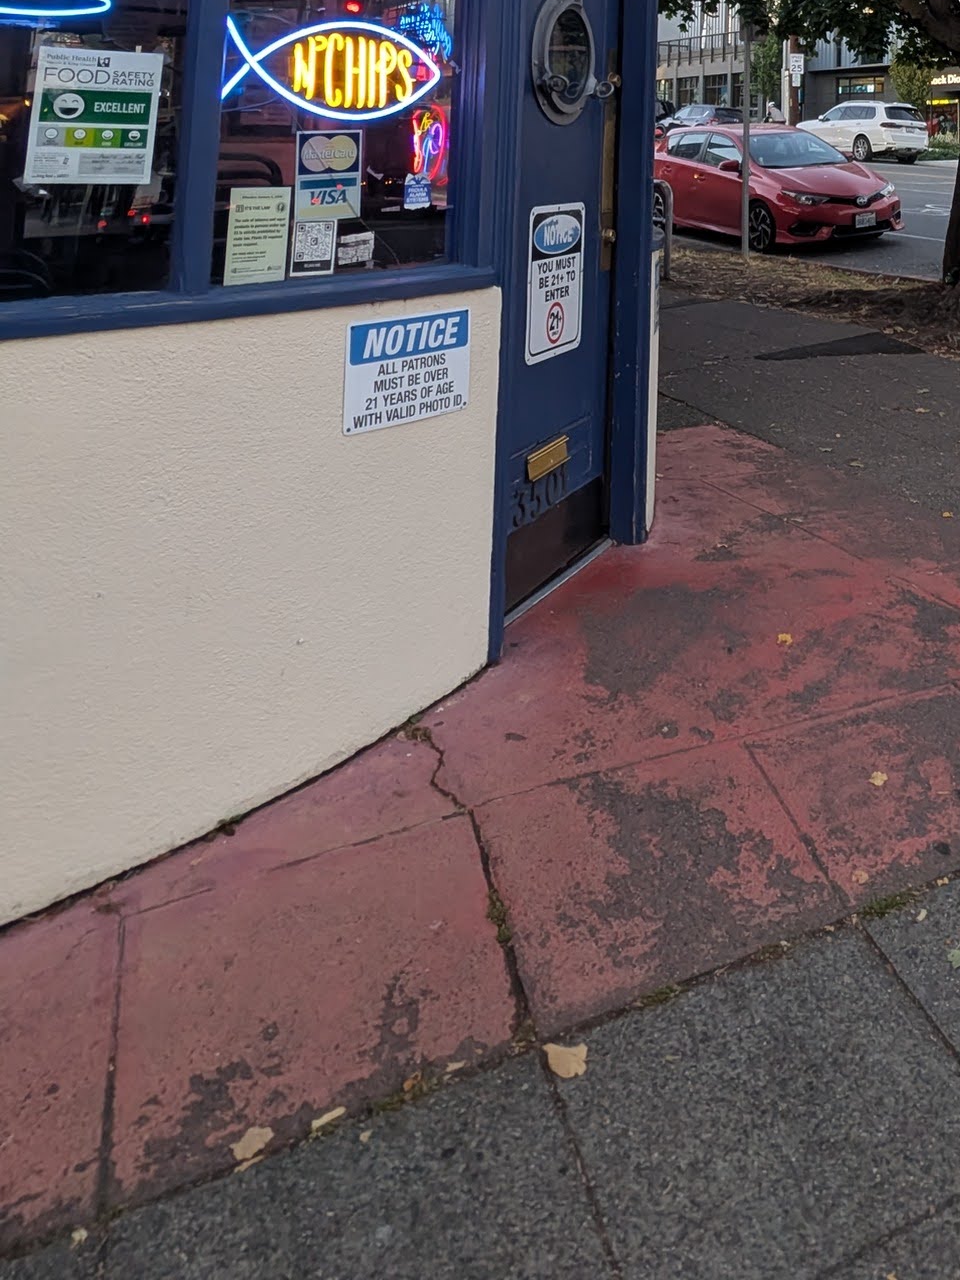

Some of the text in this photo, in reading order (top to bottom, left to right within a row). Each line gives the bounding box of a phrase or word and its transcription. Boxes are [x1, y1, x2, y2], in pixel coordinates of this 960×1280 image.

[46, 53, 70, 61] Public
[44, 67, 110, 84] FOOD
[113, 70, 155, 80] SAFETY
[791, 64, 802, 72] 25
[112, 79, 154, 87] RATING
[93, 102, 146, 114] EXCELLENT
[310, 189, 348, 206] VISA
[537, 256, 576, 275] YOU MUST
[539, 270, 575, 289] BE 21+ TO
[545, 285, 570, 302] ENTER
[549, 310, 562, 332] 21+
[362, 316, 460, 359] NOTICE
[377, 353, 446, 377] ALL PATRONS
[373, 367, 449, 393] MUST BE OVER
[365, 380, 454, 411] 21 YEARS OF AGE
[353, 393, 463, 429] WITH VALID PHOTO ID
